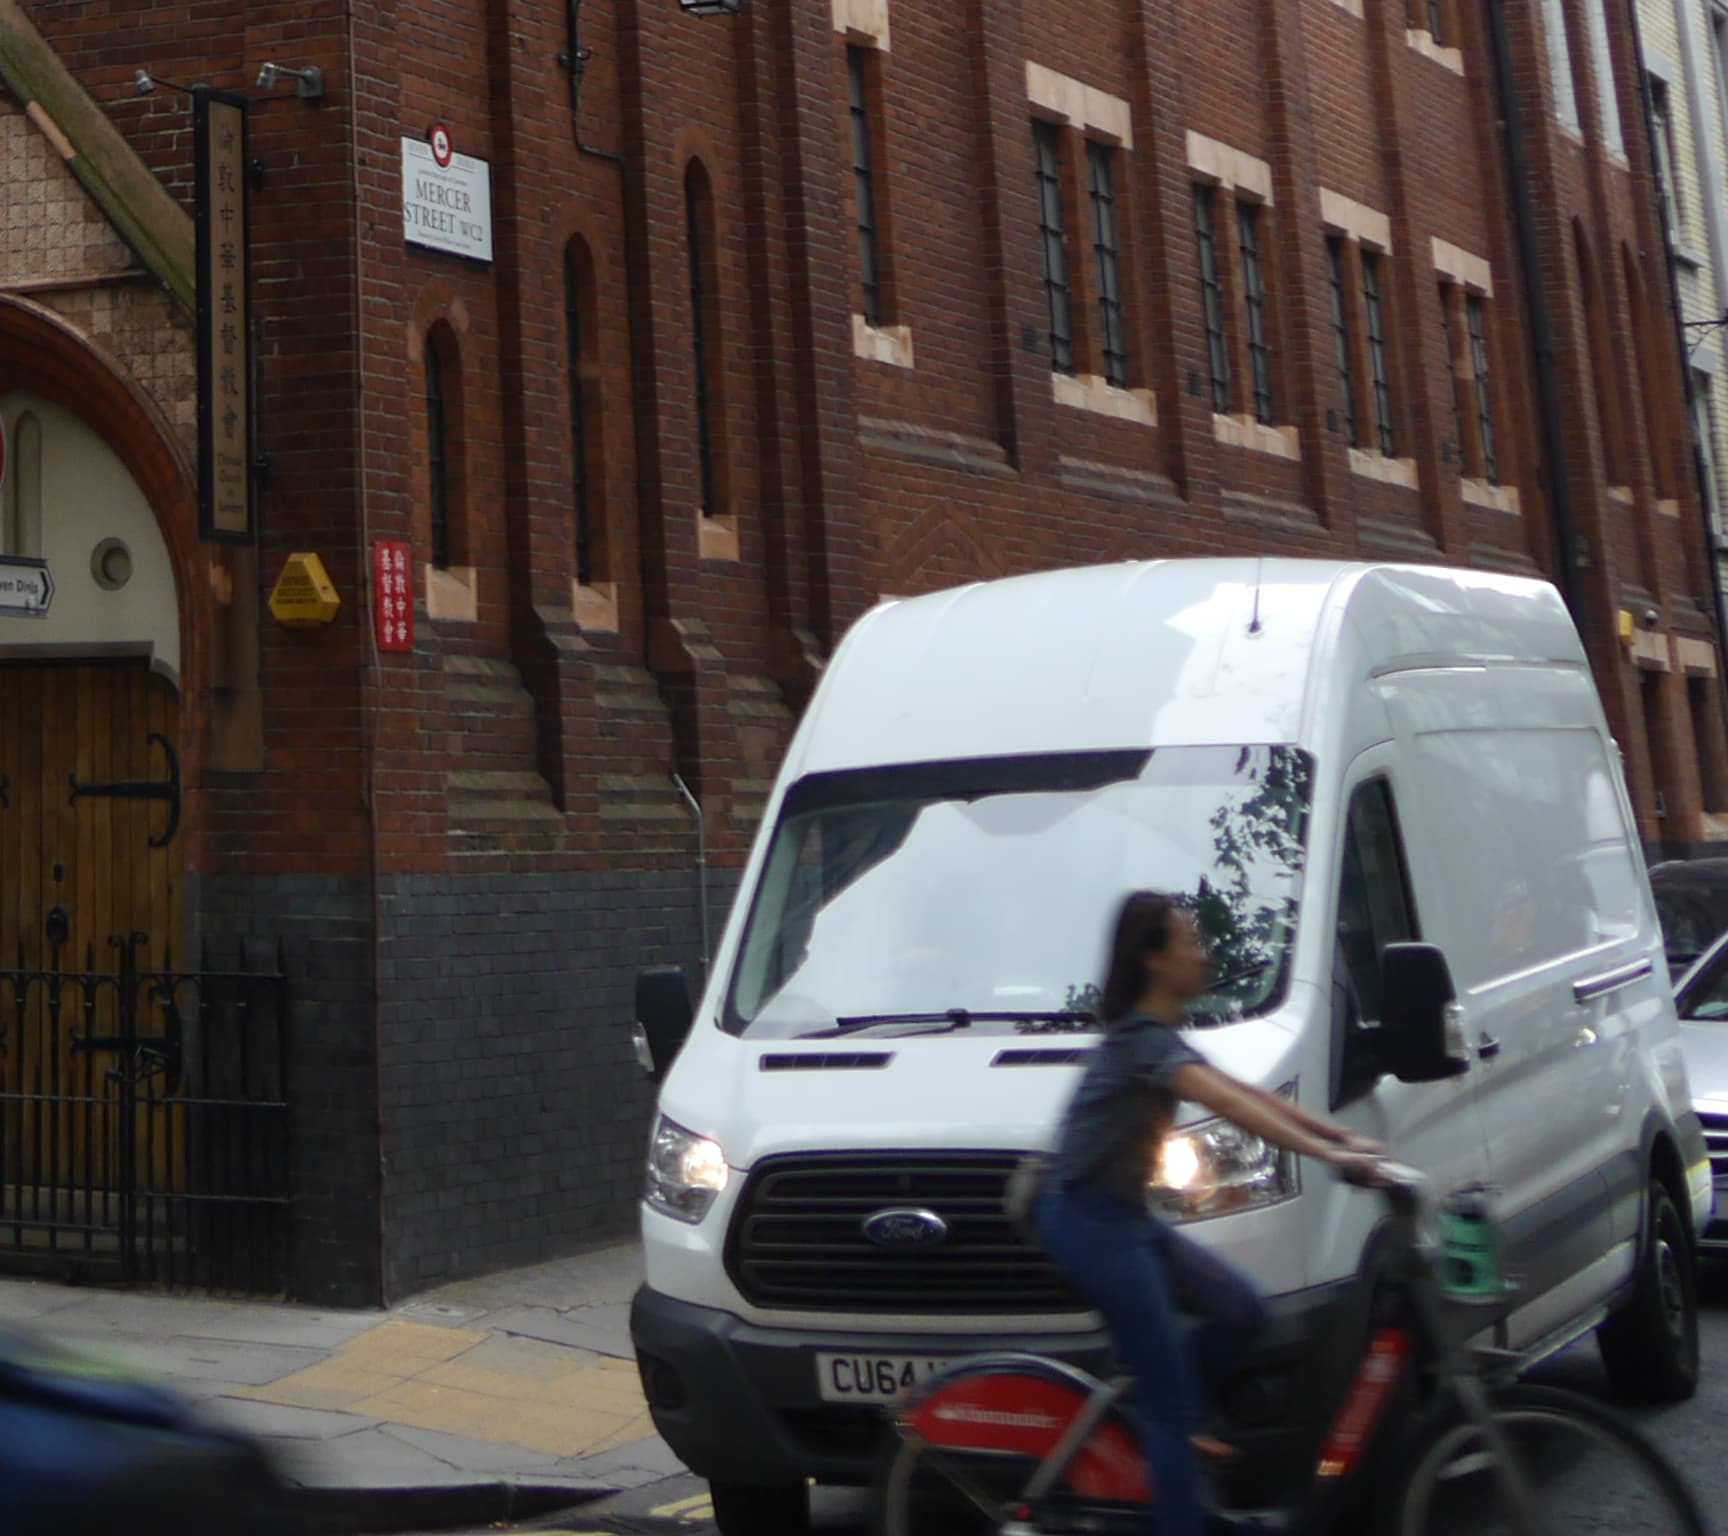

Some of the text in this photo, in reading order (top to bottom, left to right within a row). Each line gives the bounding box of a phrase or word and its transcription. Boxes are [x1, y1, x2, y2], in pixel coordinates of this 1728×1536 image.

[416, 178, 472, 213] MERCER
[404, 201, 456, 234] STREET
[459, 220, 483, 242] WC2
[831, 1357, 916, 1395] CU64
